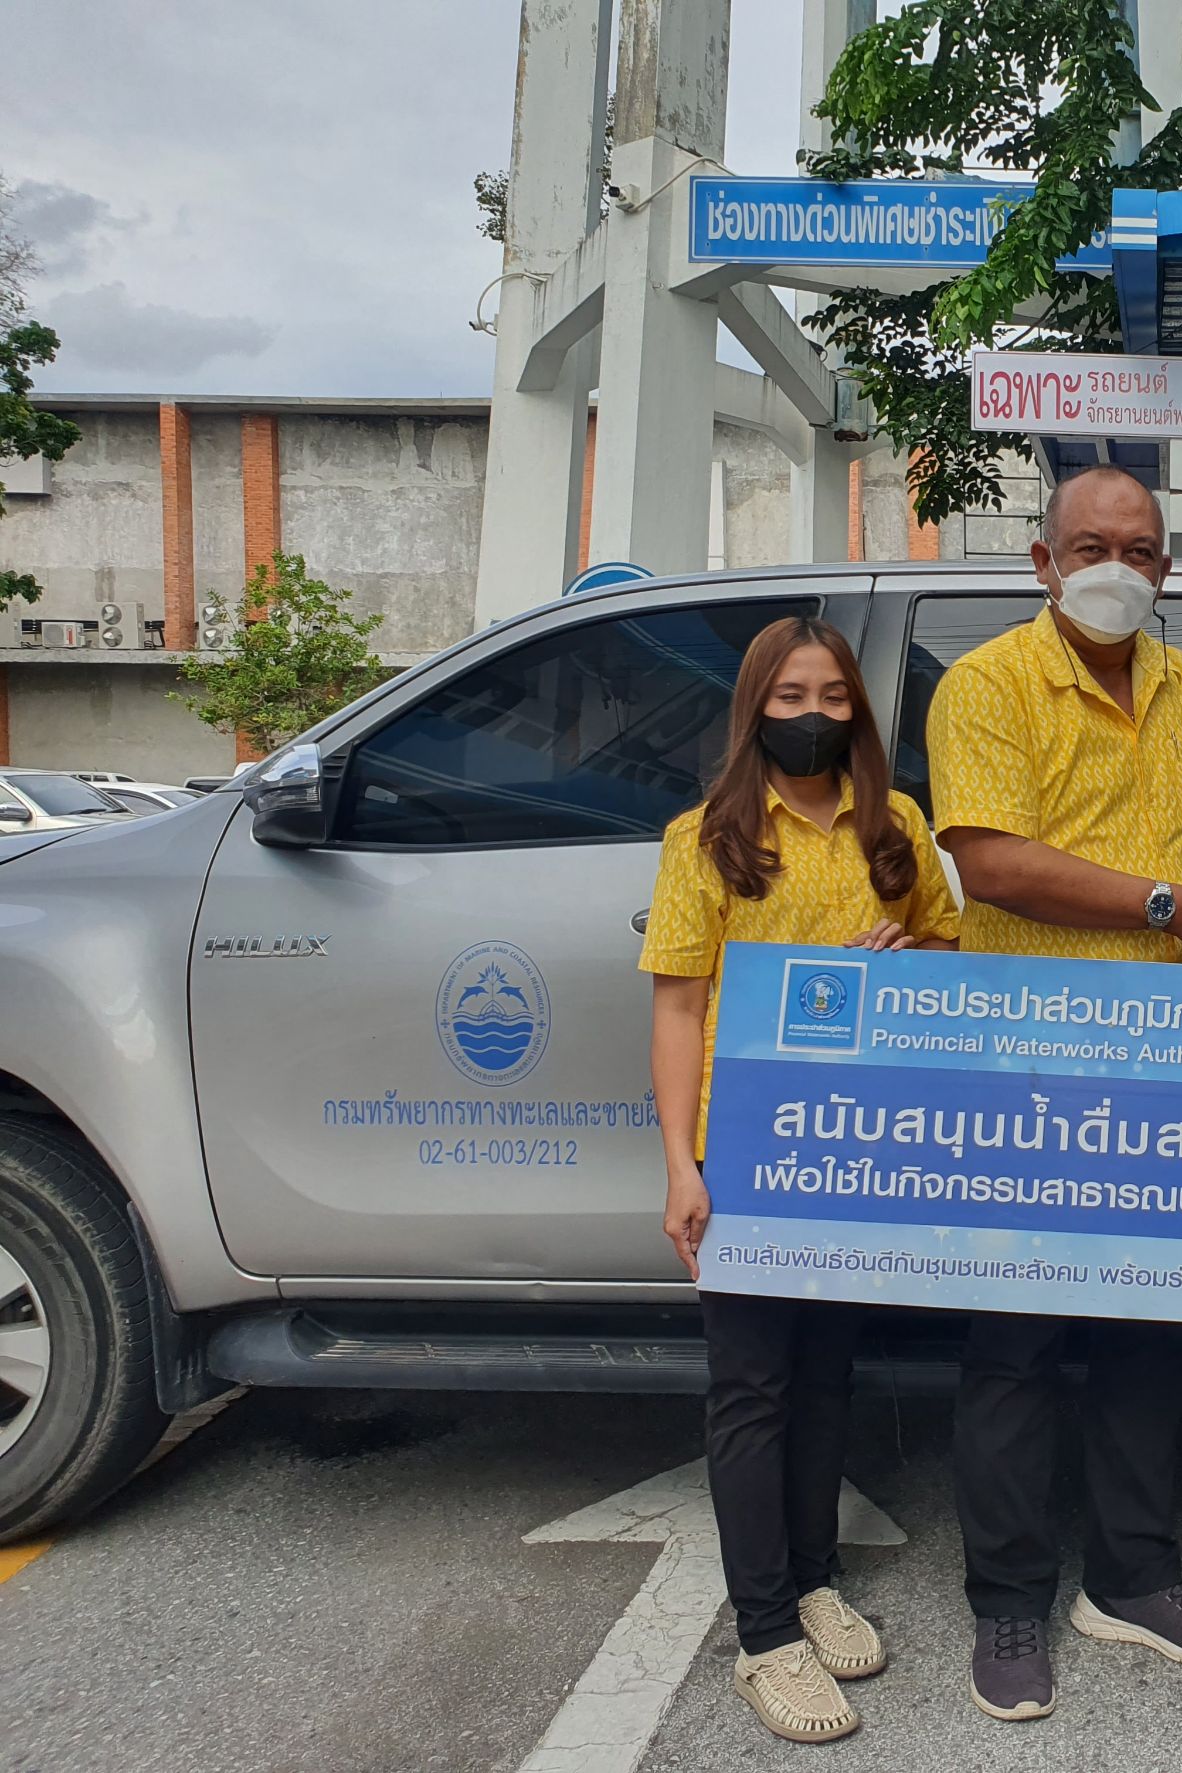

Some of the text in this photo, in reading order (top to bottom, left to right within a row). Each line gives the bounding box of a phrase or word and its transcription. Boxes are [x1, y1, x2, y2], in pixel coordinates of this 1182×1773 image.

[1087, 362, 1169, 394] รถยนต์
[978, 367, 1081, 422] เฉพาะ
[203, 933, 332, 958] HILUX
[493, 946, 509, 954] AND
[509, 951, 532, 977] COASTAL
[871, 1028, 984, 1054] Provincial
[993, 1034, 1129, 1062] Waterworks
[418, 1138, 578, 1167] 02-61-003/212
[717, 1243, 1090, 1285] สานสัมพันธ์อันดีกับชุมชนและสังคม
